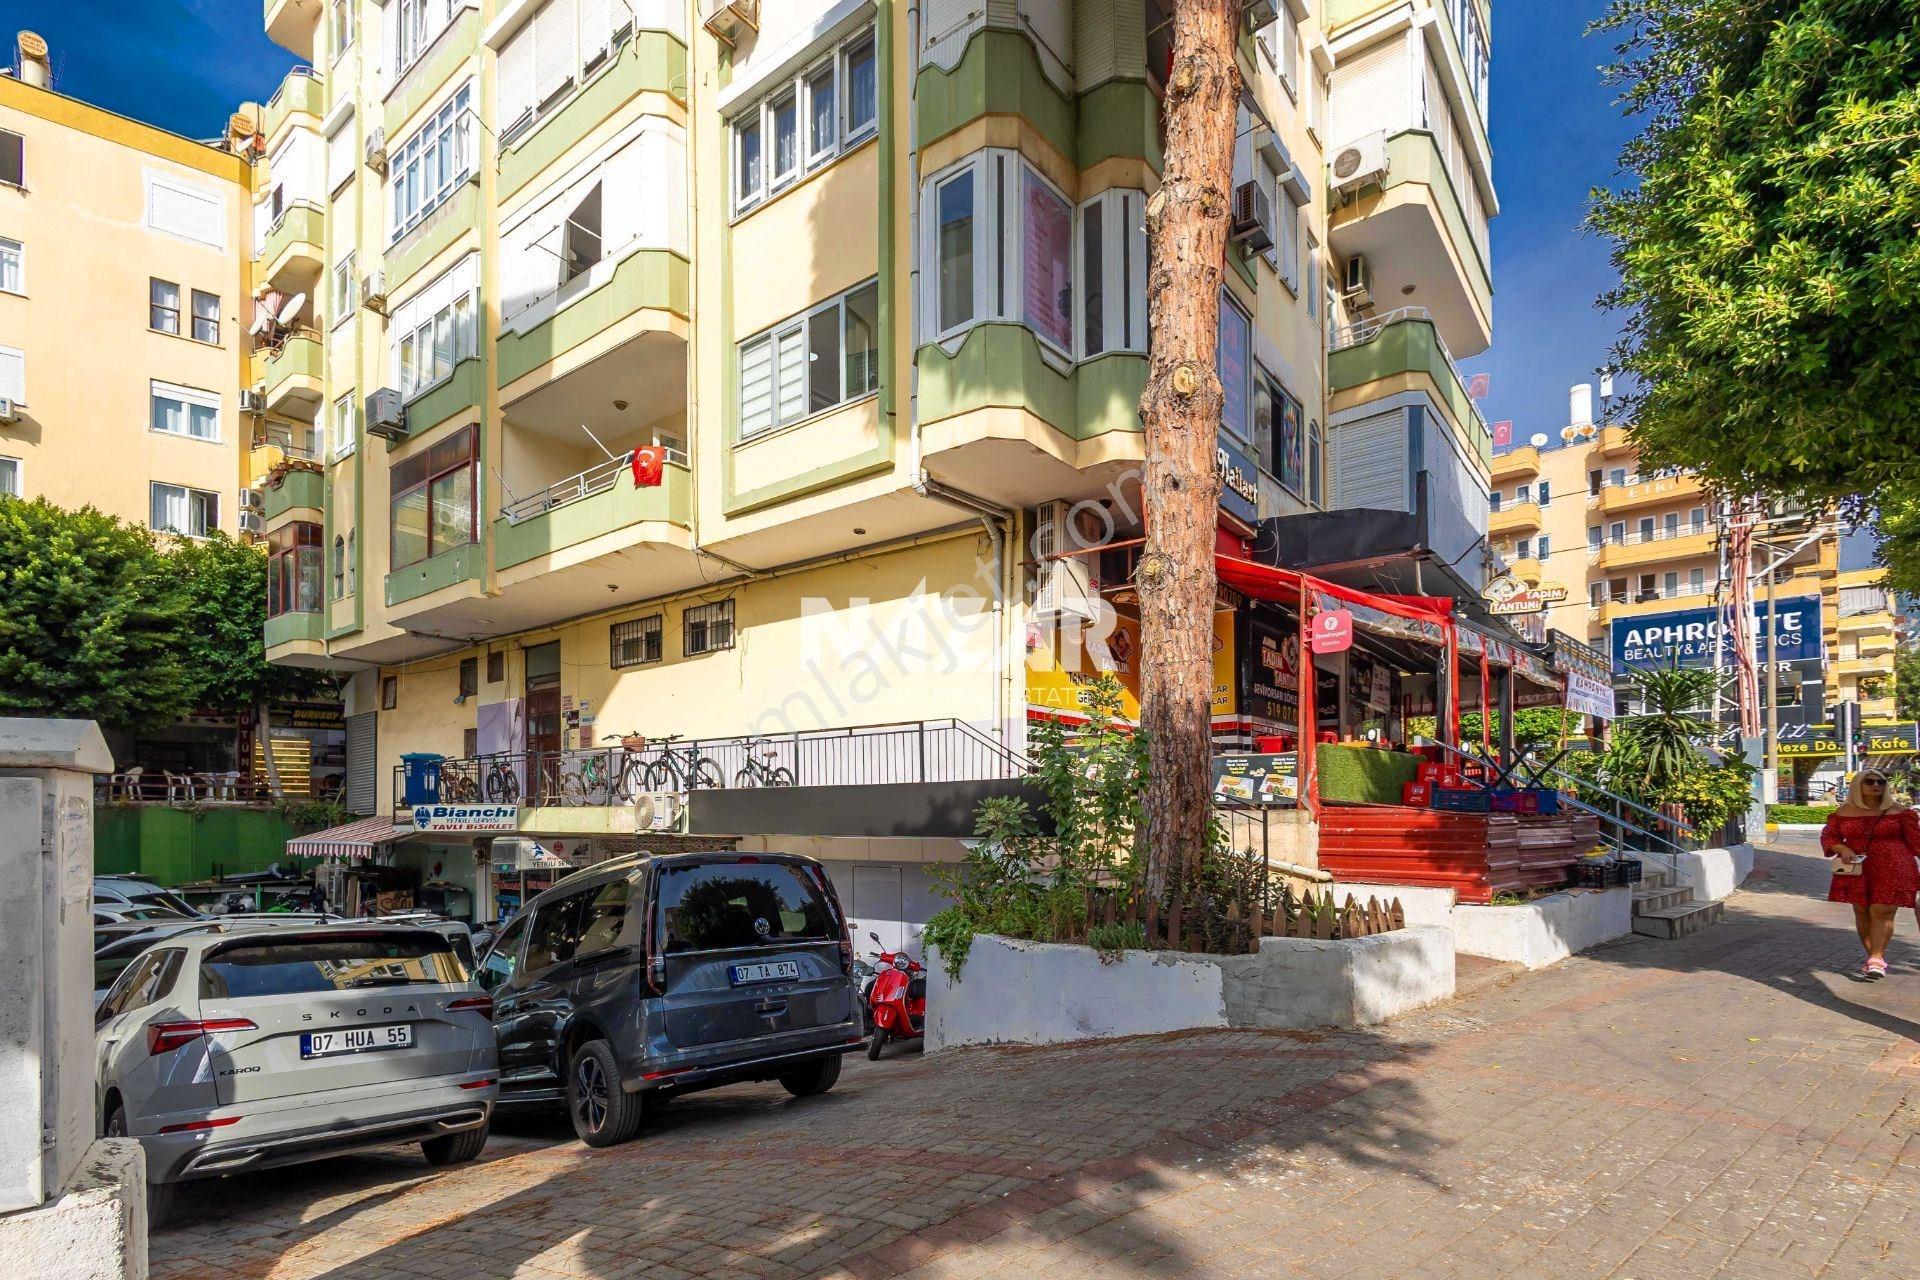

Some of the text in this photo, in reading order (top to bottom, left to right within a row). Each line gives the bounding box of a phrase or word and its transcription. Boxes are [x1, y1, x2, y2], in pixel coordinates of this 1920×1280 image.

[1871, 737, 1909, 749] Kafe
[433, 806, 517, 818] Bianchi
[737, 963, 796, 980] 07 TA 874
[313, 1027, 407, 1051] 07 HUA 55
[219, 1065, 261, 1077] KAROQ
